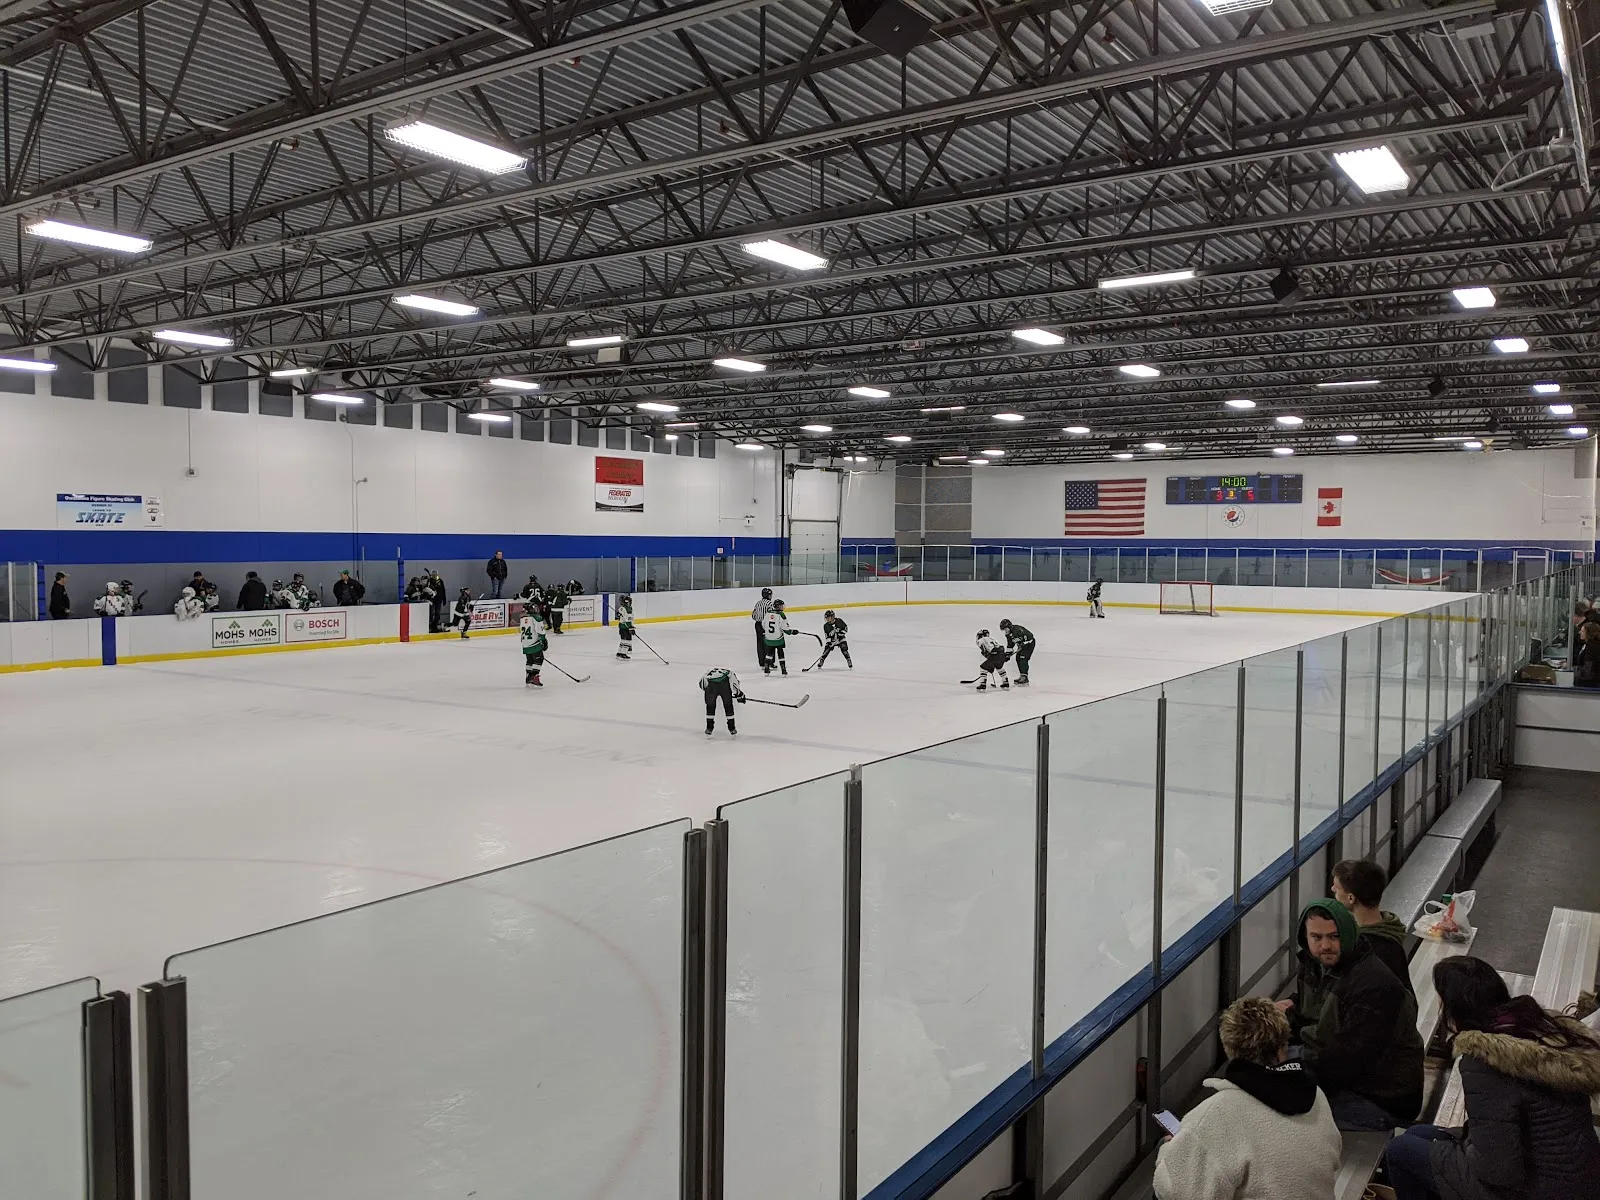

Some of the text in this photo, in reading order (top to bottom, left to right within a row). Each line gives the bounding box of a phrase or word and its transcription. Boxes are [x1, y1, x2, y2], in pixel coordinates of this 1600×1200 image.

[1221, 477, 1246, 487] 14:00
[1247, 490, 1254, 501] 5
[76, 512, 126, 523] SKATE
[529, 588, 541, 598] 26
[308, 619, 339, 629] BOSCH
[768, 621, 775, 633] 5
[215, 628, 277, 640] MOHS MOHS
